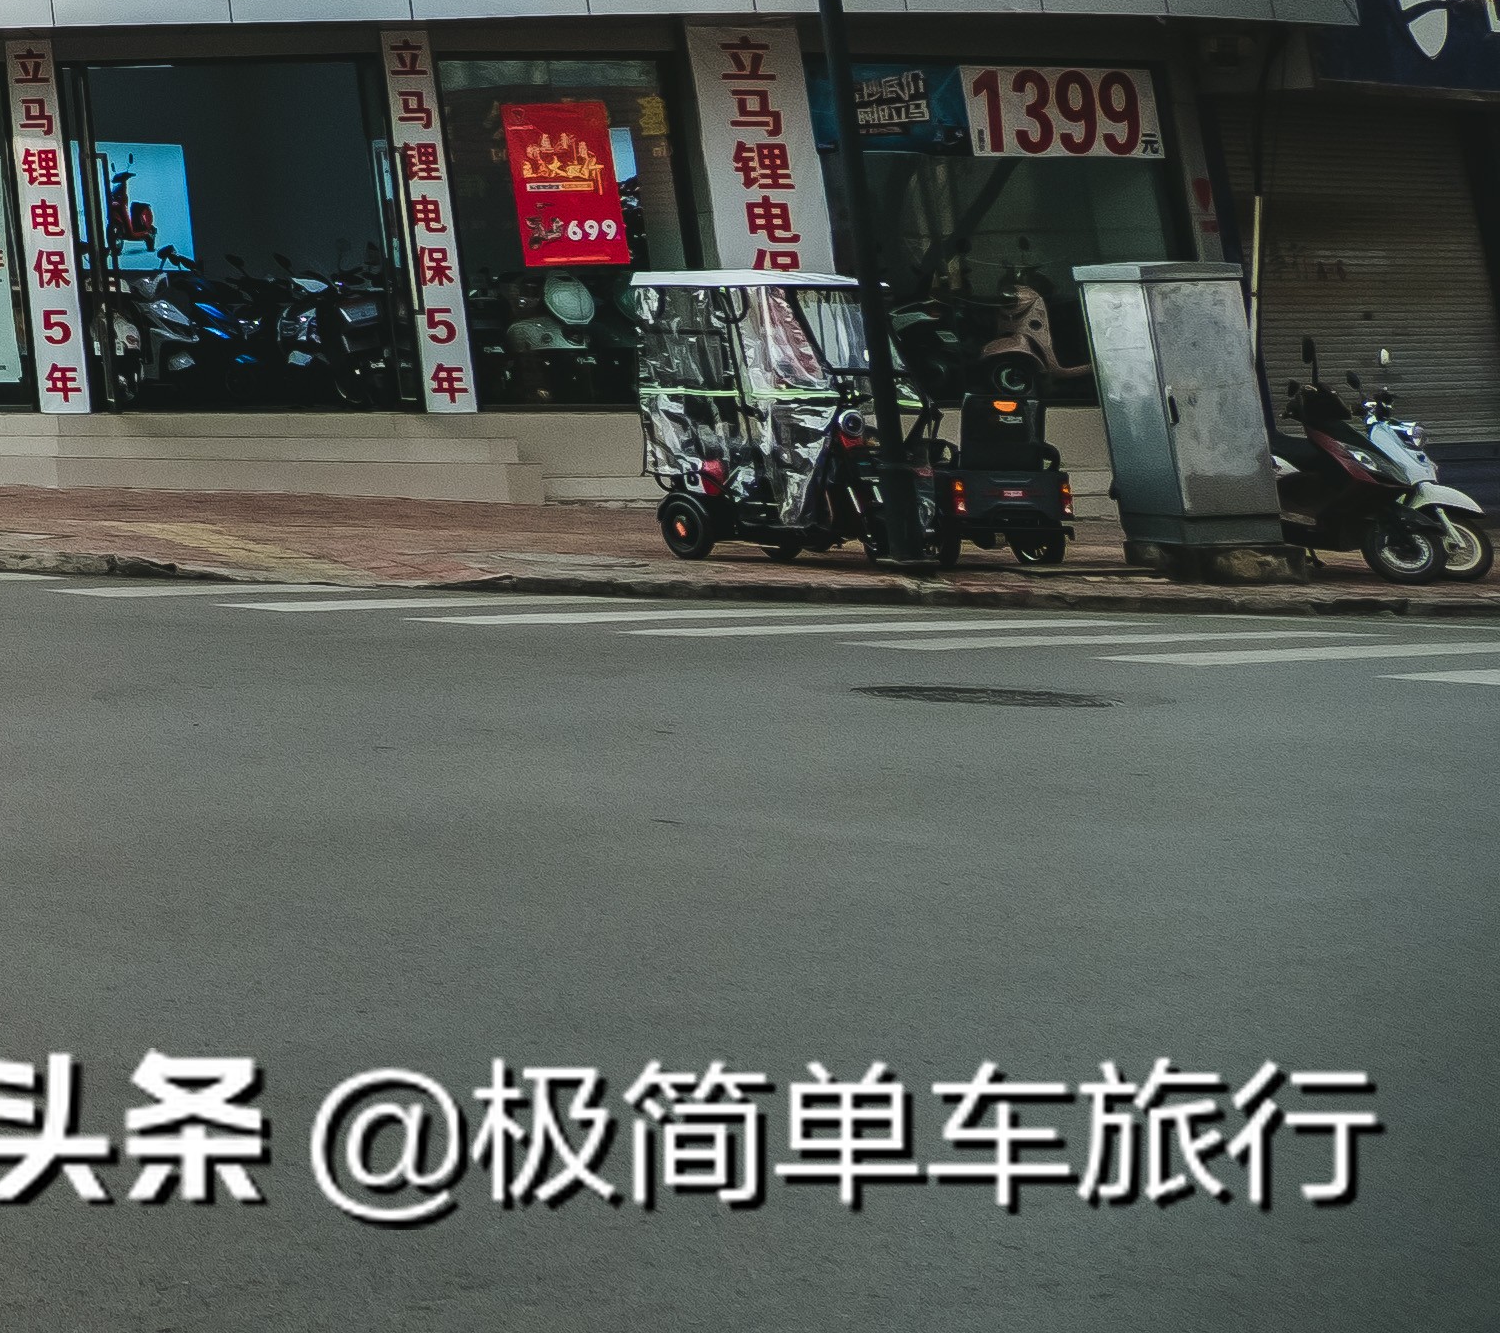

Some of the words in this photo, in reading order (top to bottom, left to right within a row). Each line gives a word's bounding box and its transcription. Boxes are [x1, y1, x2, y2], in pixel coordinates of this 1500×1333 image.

[14, 49, 82, 403] 立马锂电保5年
[390, 40, 469, 405] 立马锂电保5年
[567, 219, 617, 241] 699
